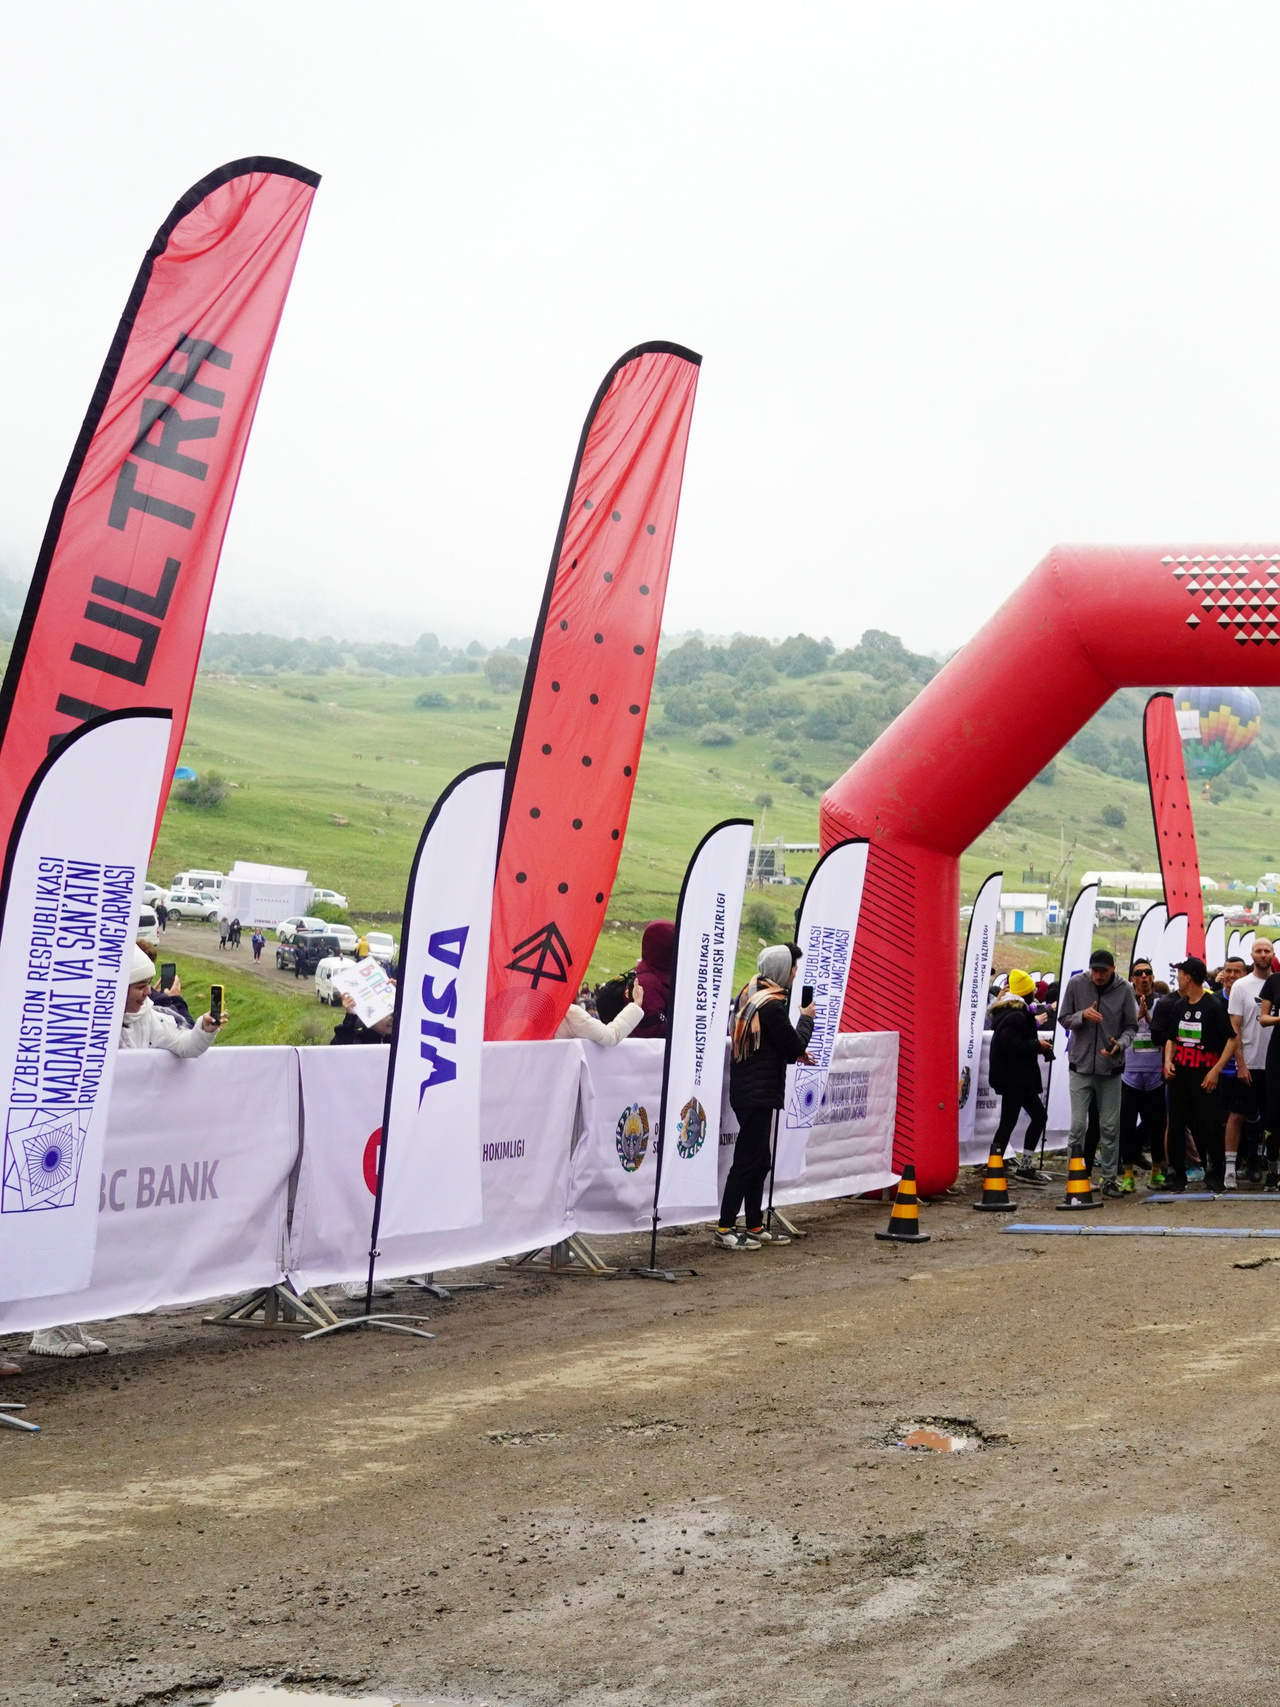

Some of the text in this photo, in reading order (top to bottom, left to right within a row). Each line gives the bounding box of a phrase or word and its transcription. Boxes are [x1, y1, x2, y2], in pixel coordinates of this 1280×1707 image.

[70, 331, 233, 687] ULTRA
[10, 857, 65, 1103] O'ZBEKISTON RESPUBLIKASI
[42, 860, 101, 1103] MADANIYAT VA SAN'ATNI
[78, 865, 135, 1103] RIVOJLANTIRISH JAMG'ARMASI
[696, 933, 710, 1010] RESPUBLIKASI
[713, 893, 726, 945] VAZIRLIGI
[417, 925, 470, 1114] VISA
[136, 1159, 221, 1210] BANK
[482, 1139, 526, 1162] HOKIMLIGI
